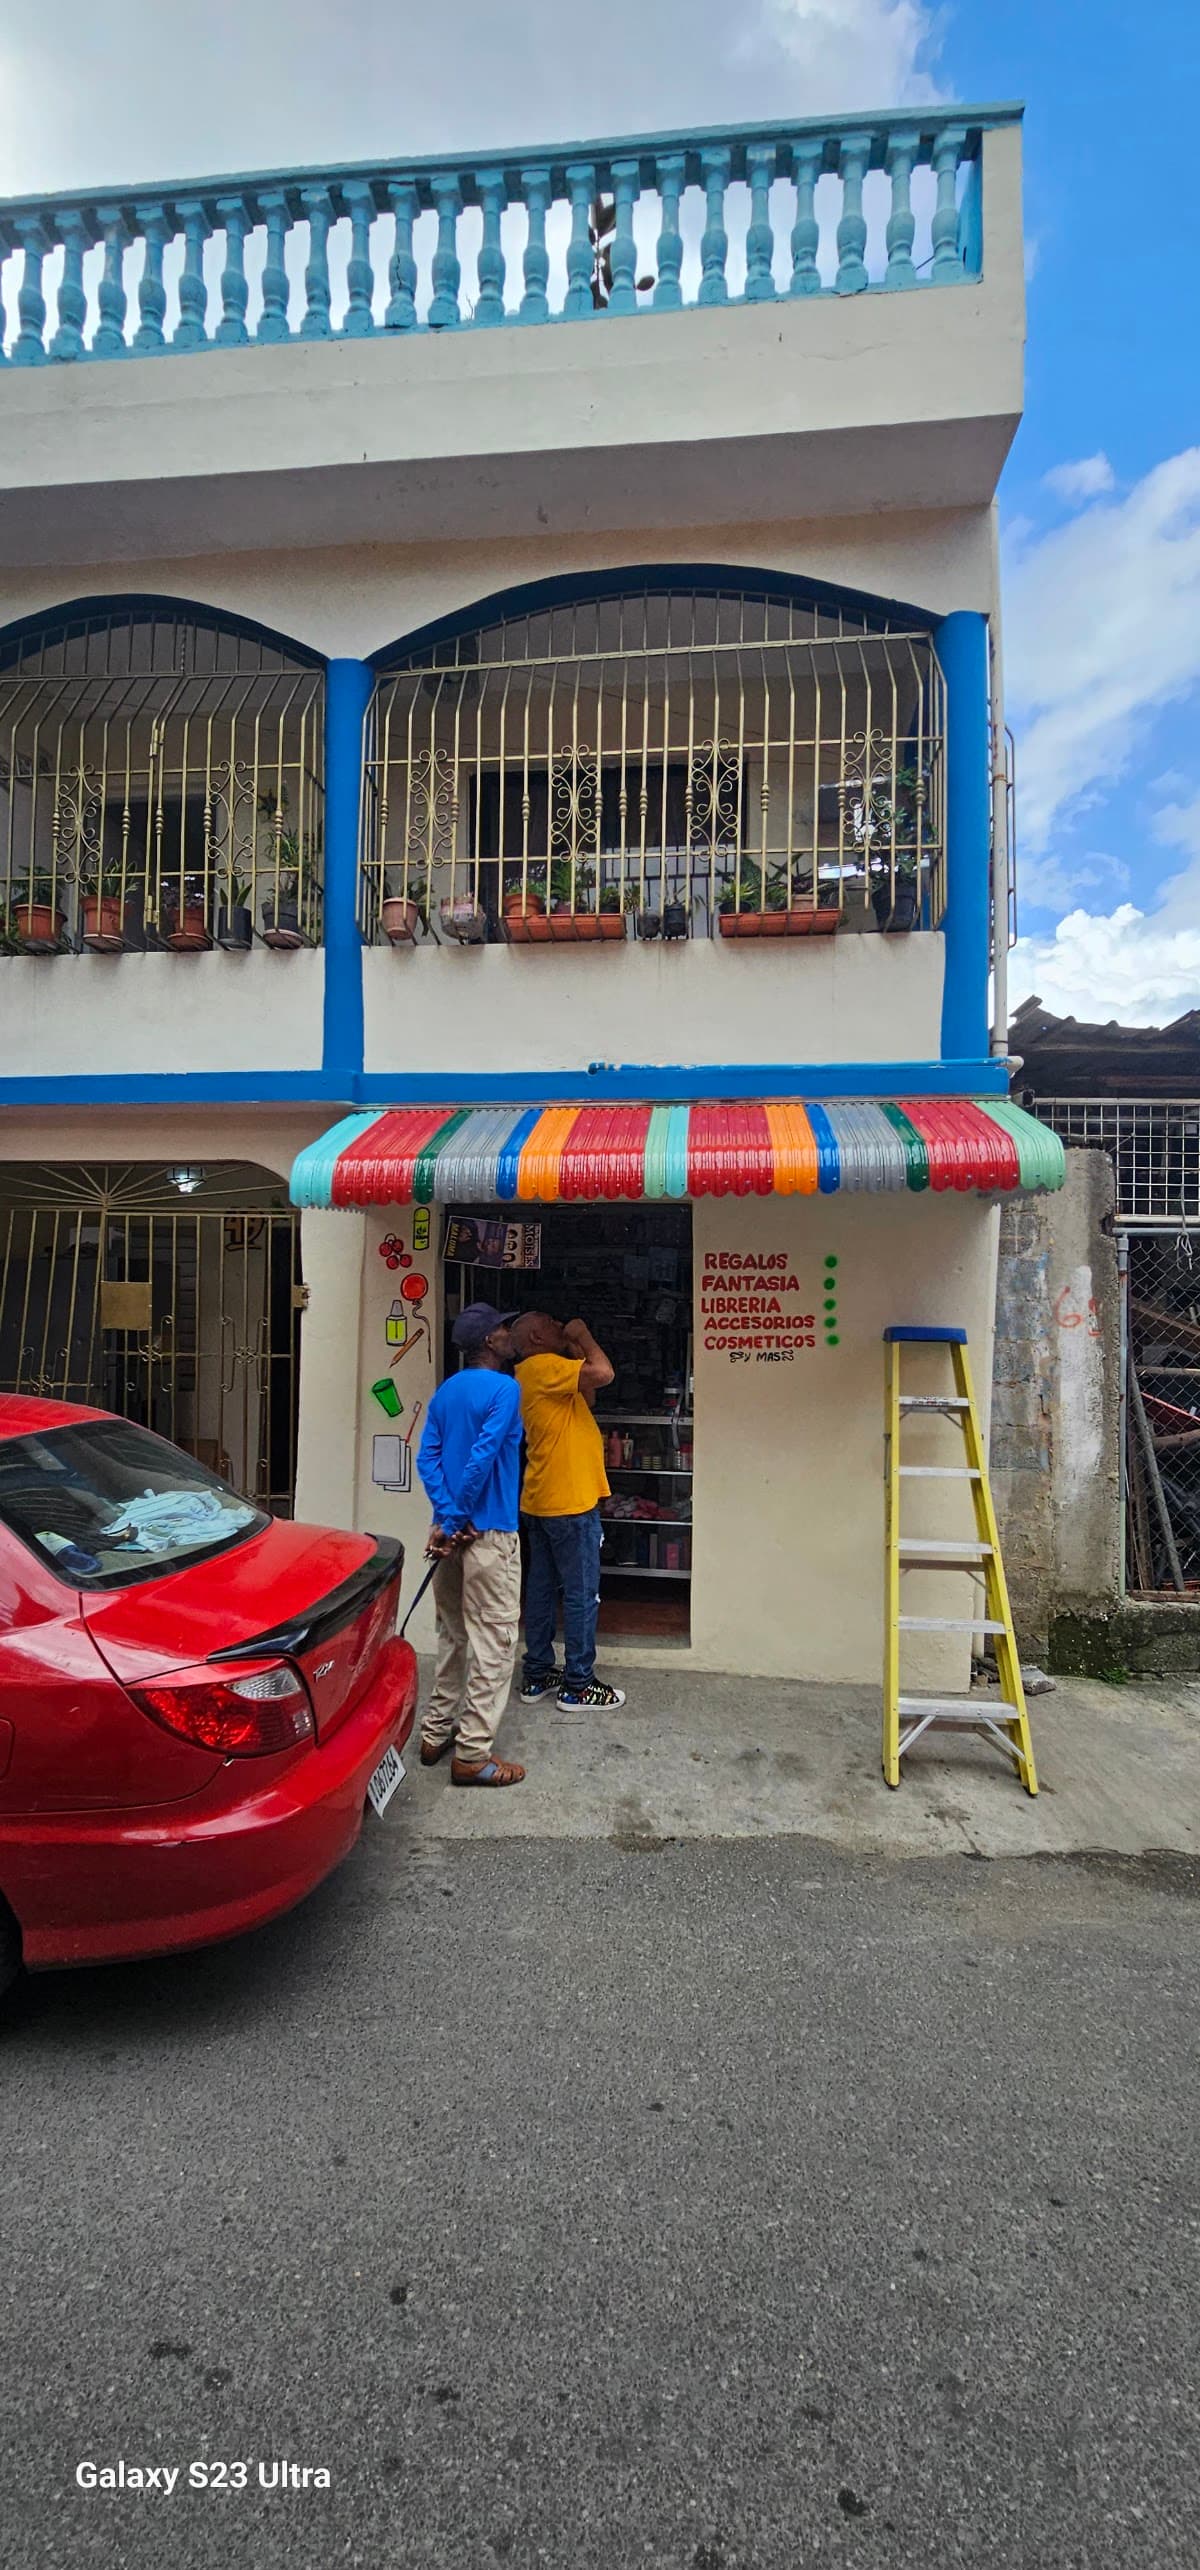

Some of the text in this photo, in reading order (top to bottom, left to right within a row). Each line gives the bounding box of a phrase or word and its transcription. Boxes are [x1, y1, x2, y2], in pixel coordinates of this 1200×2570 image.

[446, 1223, 460, 1257] MALUMA
[704, 1253, 788, 1270] REGALOS
[701, 1275, 800, 1292] FANTASIA
[700, 1296, 782, 1314] LIBRERIA
[704, 1315, 816, 1330] ACCESORIOS
[704, 1334, 816, 1350] COSMETICOS
